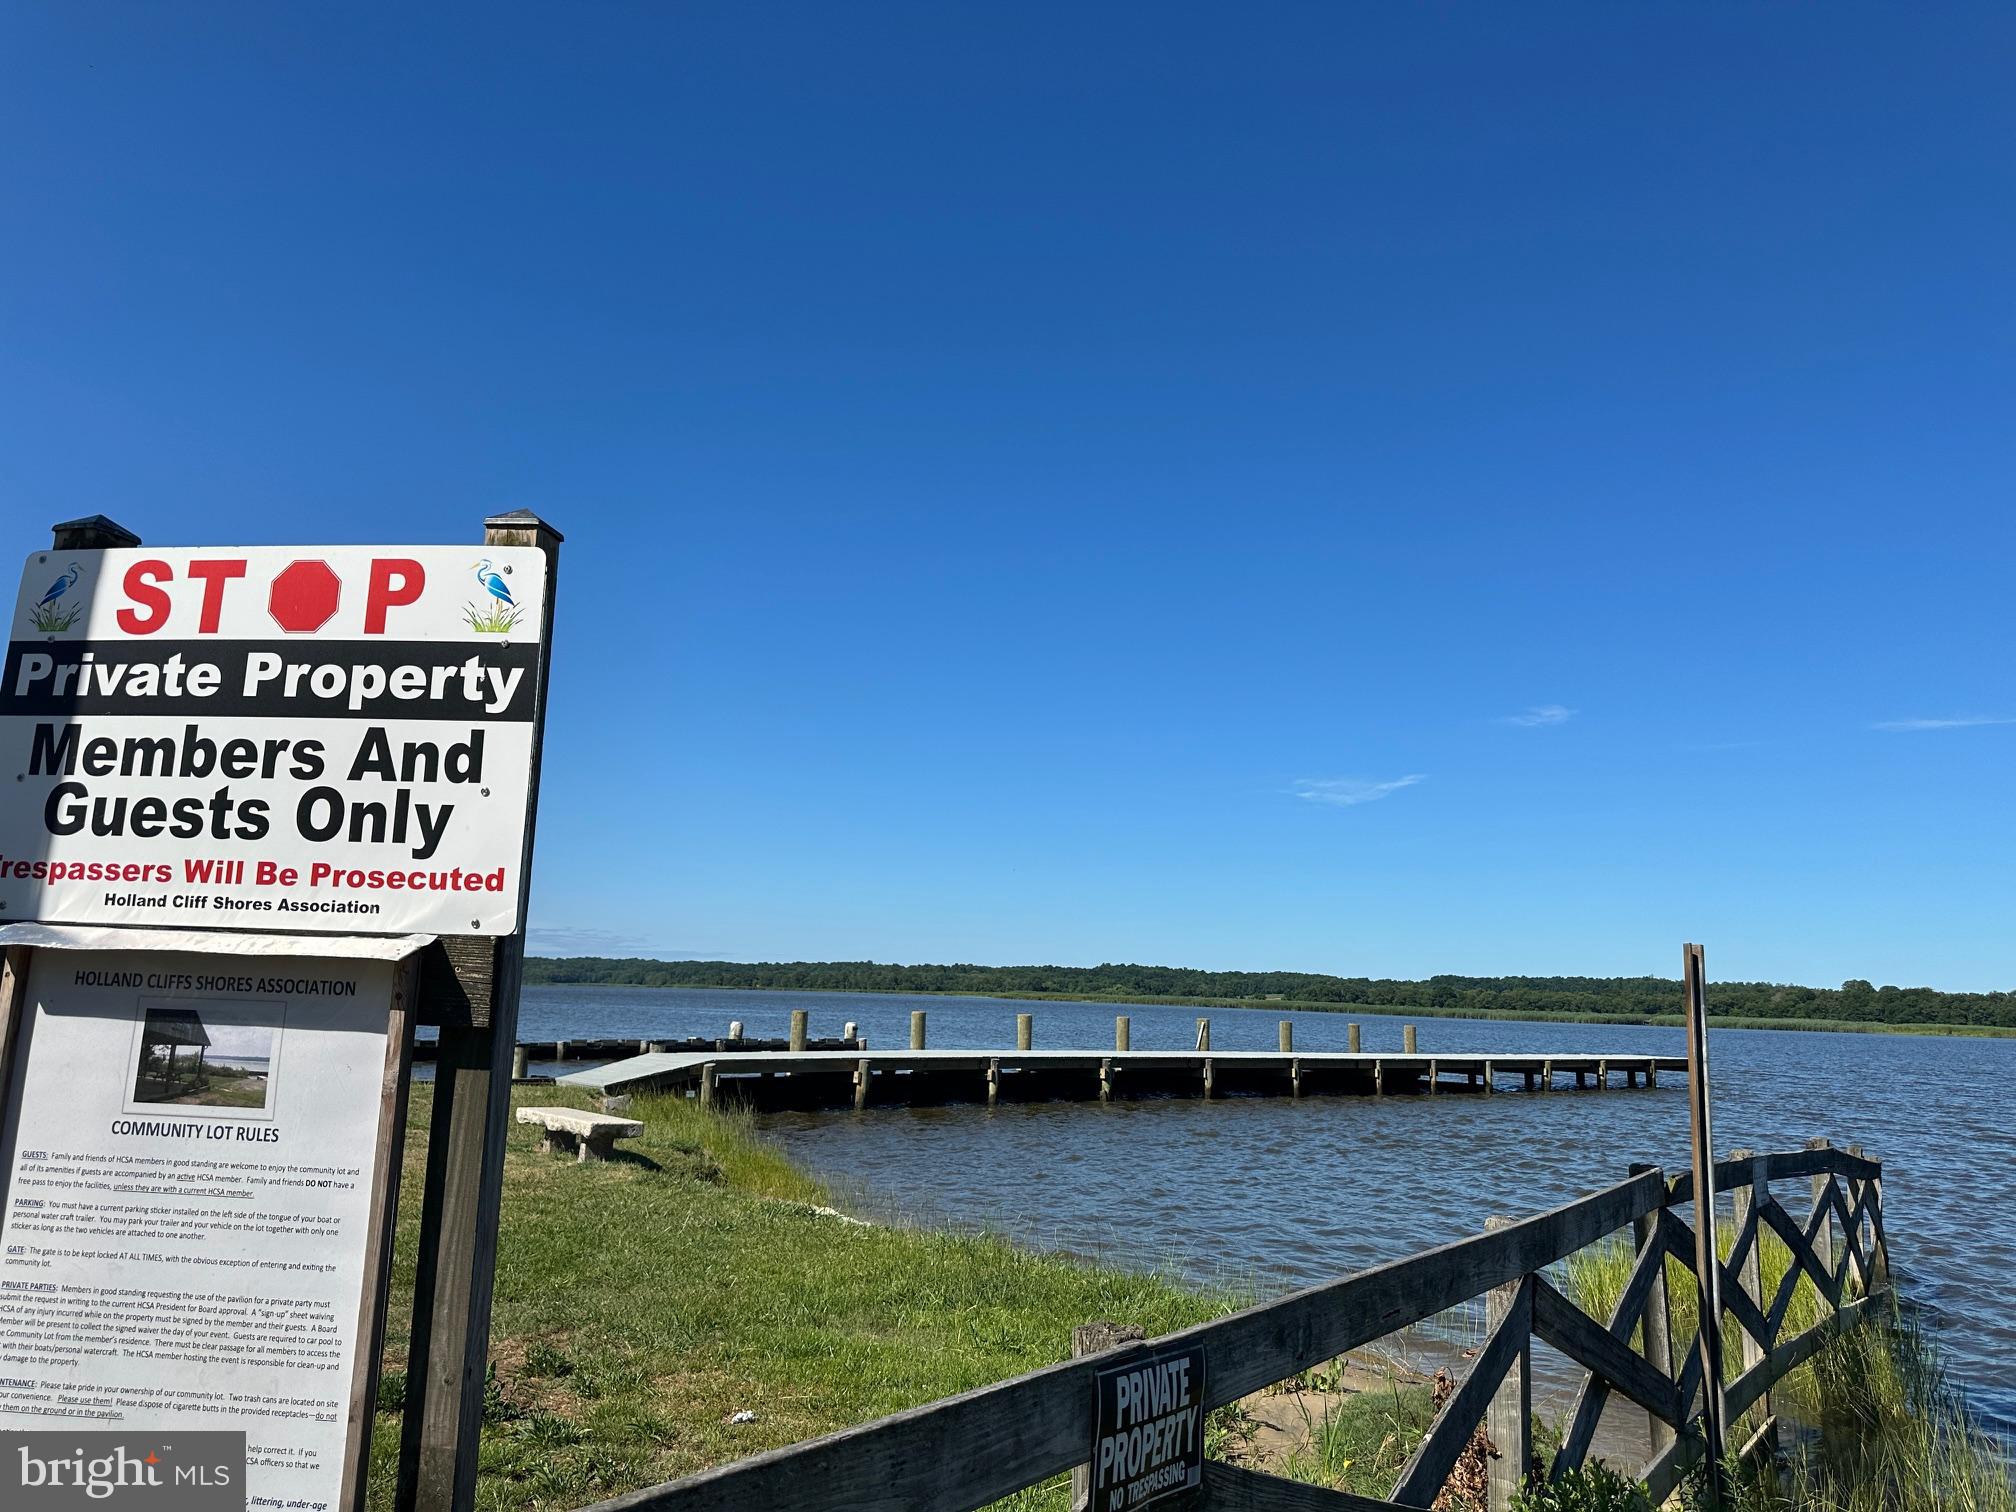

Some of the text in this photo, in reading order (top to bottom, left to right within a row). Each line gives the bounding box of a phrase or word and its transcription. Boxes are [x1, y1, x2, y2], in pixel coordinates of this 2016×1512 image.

[14, 652, 524, 714] Private Property
[28, 723, 485, 784] Members And
[44, 782, 455, 860] Guests Only
[0, 855, 505, 892] respassers Will Be Prosecuted
[104, 893, 380, 914] Holland Cliff Shores Association
[74, 970, 356, 996] HOLLAND CLIFFS SHORES ASSOCIATION
[112, 1120, 280, 1143] COMMUNITY LOT RULES
[20, 1163, 28, 1171] all
[45, 1166, 75, 1174] amenities
[76, 1166, 81, 1174] if
[81, 1168, 102, 1176] guests
[114, 1171, 158, 1179] accompanied
[158, 1171, 167, 1181] by
[196, 1173, 214, 1181] HCSA
[246, 1176, 268, 1186] Family
[268, 1177, 282, 1185] and
[282, 1178, 305, 1186] friends
[305, 1179, 317, 1187] DO
[317, 1180, 333, 1188] NOT
[333, 1180, 349, 1188] have
[22, 1150, 49, 1159] GUESTS:
[51, 1152, 72, 1162] Family
[72, 1153, 85, 1161] and
[85, 1153, 107, 1162] friends
[116, 1155, 134, 1163] HCSA
[134, 1157, 165, 1165] members
[166, 1158, 173, 1166] in
[173, 1159, 190, 1168] good
[190, 1160, 218, 1170] standing
[230, 1162, 259, 1170] welcome
[287, 1164, 299, 1172] the
[298, 1167, 336, 1176] community
[336, 1167, 346, 1175] lot
[14, 1198, 46, 1207] PARKING:
[49, 1200, 61, 1208] You
[78, 1202, 94, 1210] have
[124, 1205, 150, 1215] parking
[150, 1206, 172, 1214] sticker
[172, 1208, 200, 1216] installed
[210, 1209, 221, 1217] the
[222, 1210, 233, 1218] left
[233, 1211, 248, 1219] side
[248, 1211, 256, 1219] of
[256, 1212, 268, 1220] the
[268, 1213, 292, 1222] tongue
[292, 1214, 300, 1222] of
[300, 1216, 316, 1224] your
[316, 1215, 332, 1223] boat
[5, 1258, 52, 1268] community lot.
[6, 1245, 27, 1253] GATE:
[30, 1246, 42, 1254] The
[41, 1248, 56, 1256] gate
[72, 1249, 80, 1257] be
[81, 1250, 96, 1259] kept
[96, 1250, 119, 1259] locked
[118, 1252, 129, 1260] AT
[128, 1252, 141, 1260] ALL
[142, 1253, 164, 1262] TIMES,
[181, 1255, 192, 1263] the
[192, 1256, 218, 1265] obvious
[219, 1259, 251, 1268] exception
[259, 1261, 288, 1271] entering
[288, 1262, 302, 1270] and
[302, 1263, 324, 1273] exiting
[325, 1264, 337, 1272] the
[1, 1280, 29, 1289] PRIVATE
[29, 1282, 59, 1291] PARTIES:
[61, 1284, 92, 1293] Members
[100, 1287, 118, 1296] good
[118, 1288, 147, 1298] standing
[146, 1291, 182, 1301] requesting
[182, 1292, 194, 1300] the
[206, 1293, 215, 1301] of
[215, 1294, 227, 1302] the
[227, 1295, 253, 1304] pavilion
[254, 1296, 264, 1304] for
[270, 1298, 294, 1306] private
[294, 1300, 313, 1309] party
[40, 1380, 61, 1389] Please
[62, 1382, 77, 1390] take
[77, 1384, 95, 1392] pride
[120, 1387, 155, 1397] ownership
[155, 1388, 163, 1396] of
[176, 1392, 214, 1401] community
[214, 1392, 225, 1400] lot.
[229, 1393, 243, 1401] Two
[290, 1397, 315, 1406] located
[326, 1400, 339, 1408] site
[1116, 1357, 1190, 1429] PRIVATE
[248, 1444, 263, 1454] help
[298, 1448, 304, 1456] If
[1098, 1406, 1198, 1488] PROPERTY
[260, 1458, 285, 1467] officers
[294, 1460, 309, 1469] that
[1109, 1460, 1186, 1512] NO TRESPASSING
[251, 1496, 328, 1512] littering, under-age
